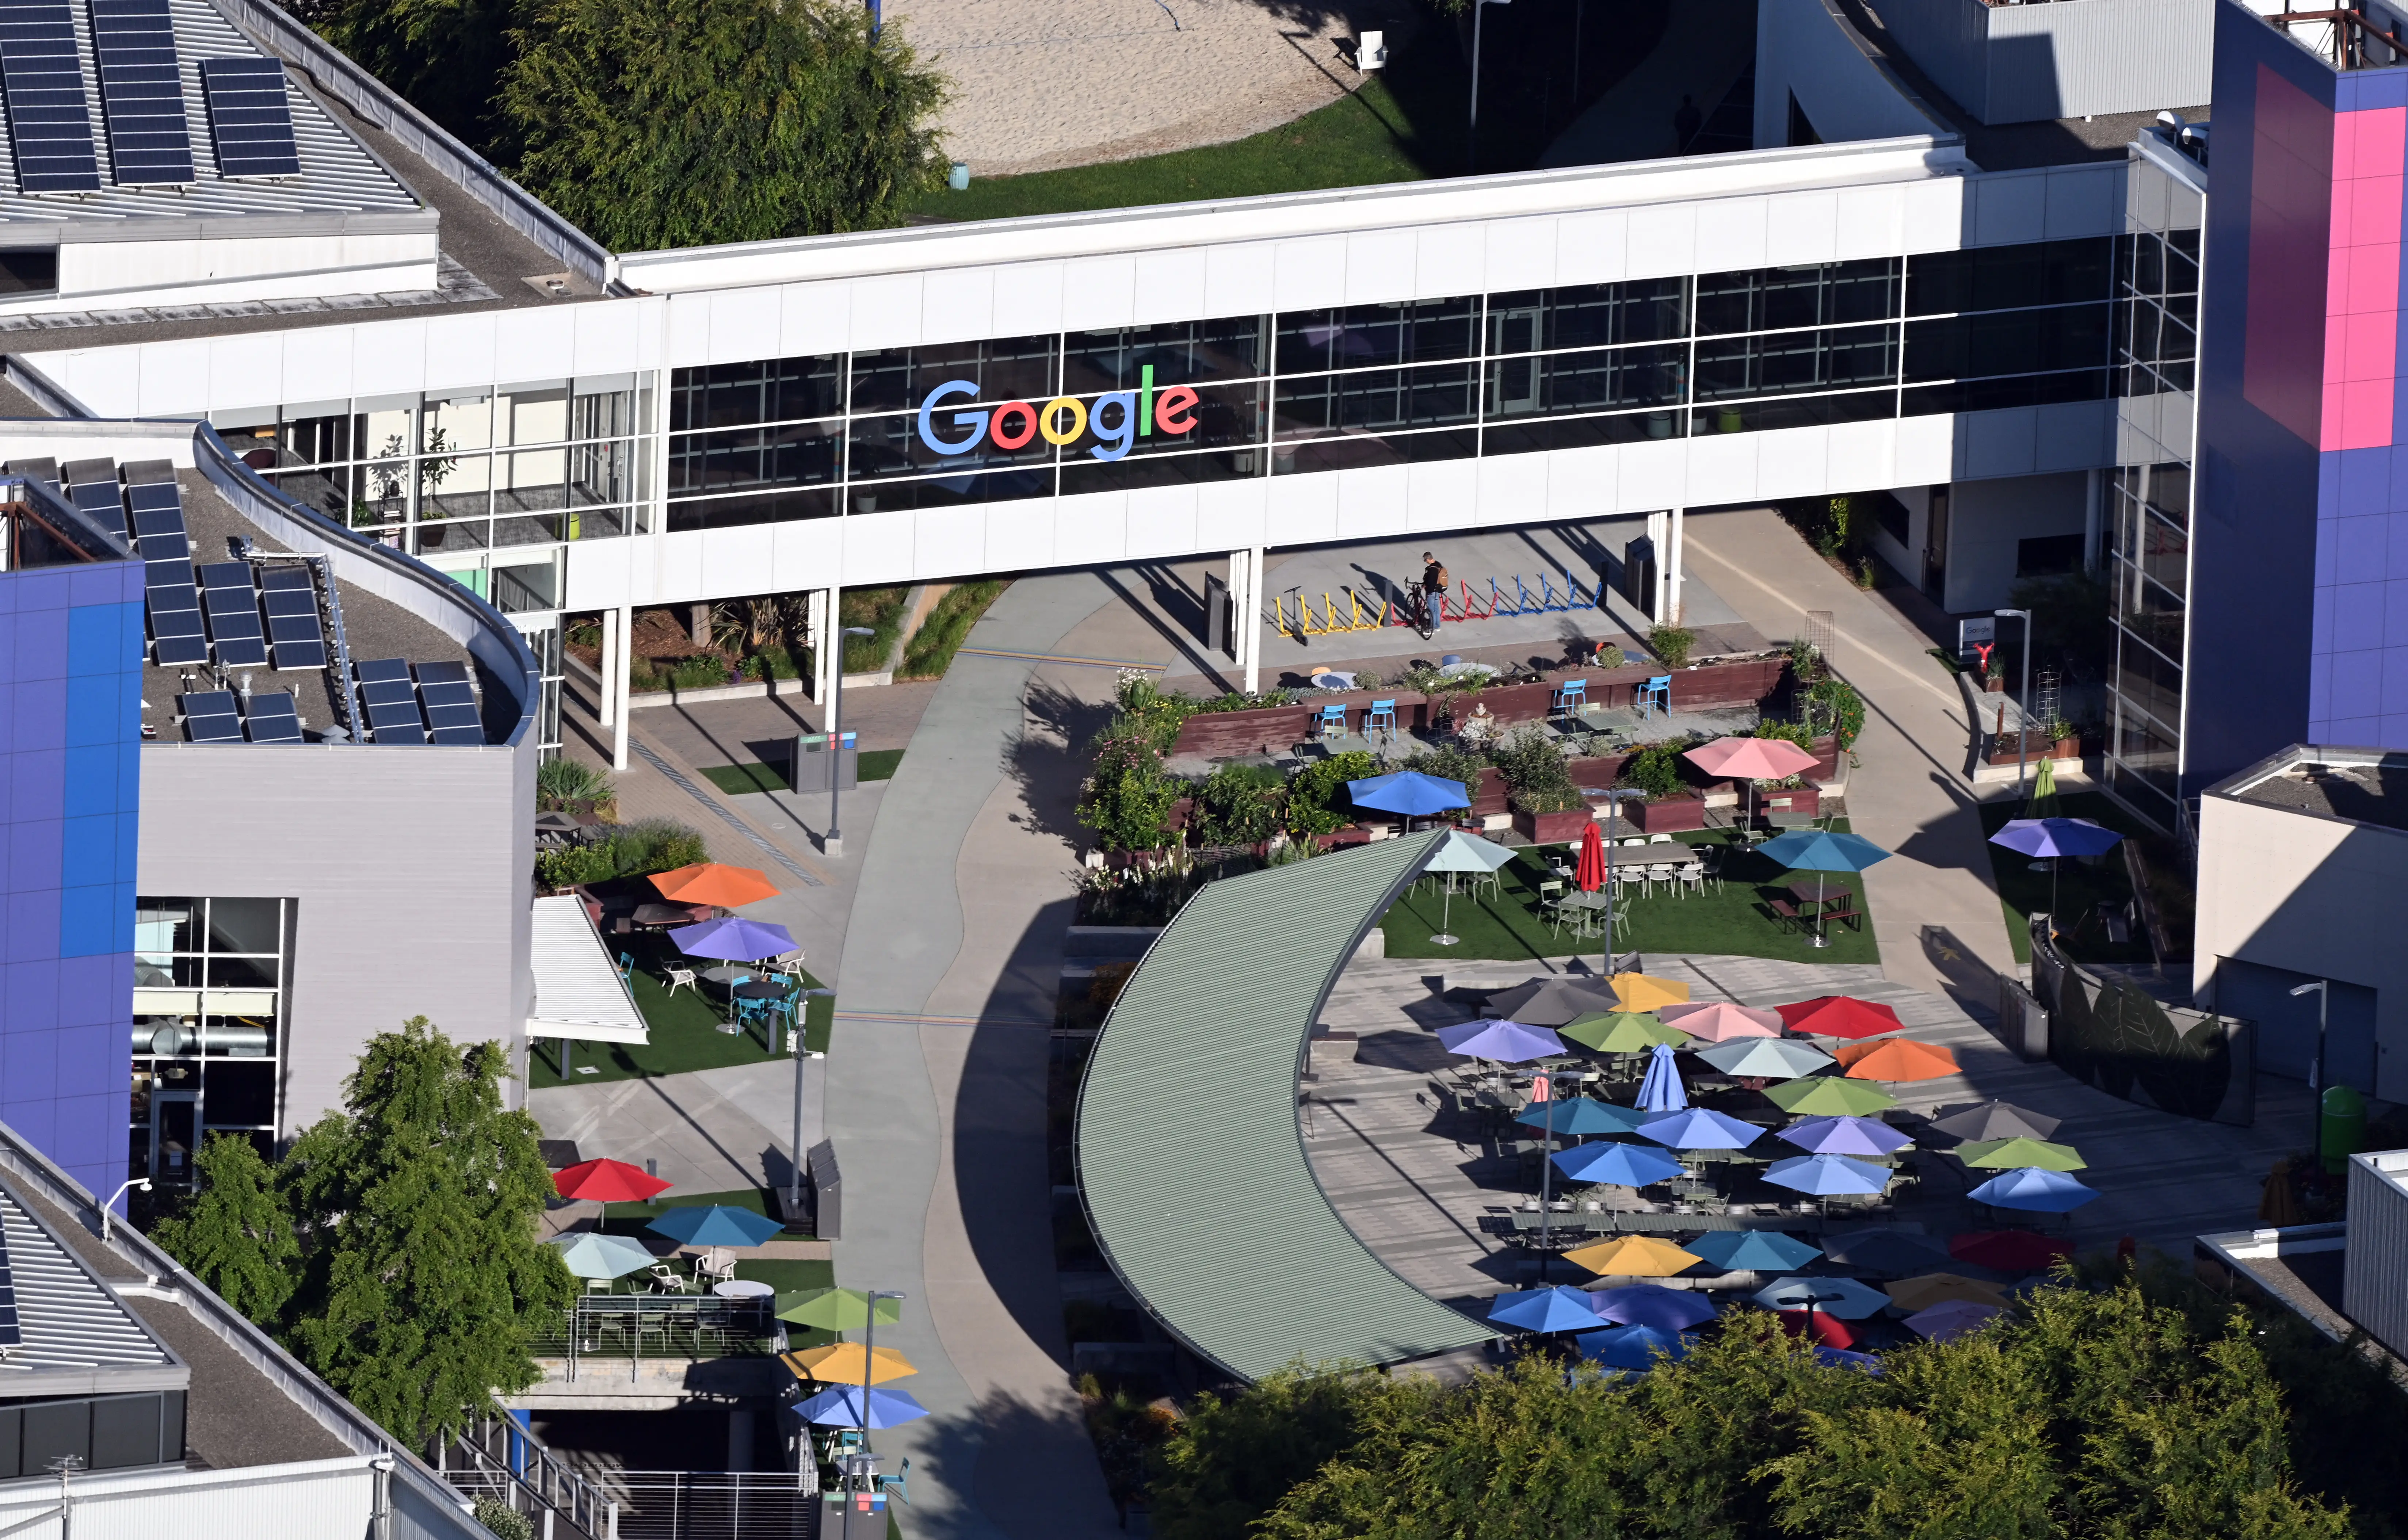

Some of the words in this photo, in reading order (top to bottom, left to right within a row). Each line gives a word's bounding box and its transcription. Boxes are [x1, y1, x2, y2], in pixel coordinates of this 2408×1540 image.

[918, 364, 1199, 462] Google
[516, 624, 541, 635] ilding
[1966, 626, 1990, 634] Google
